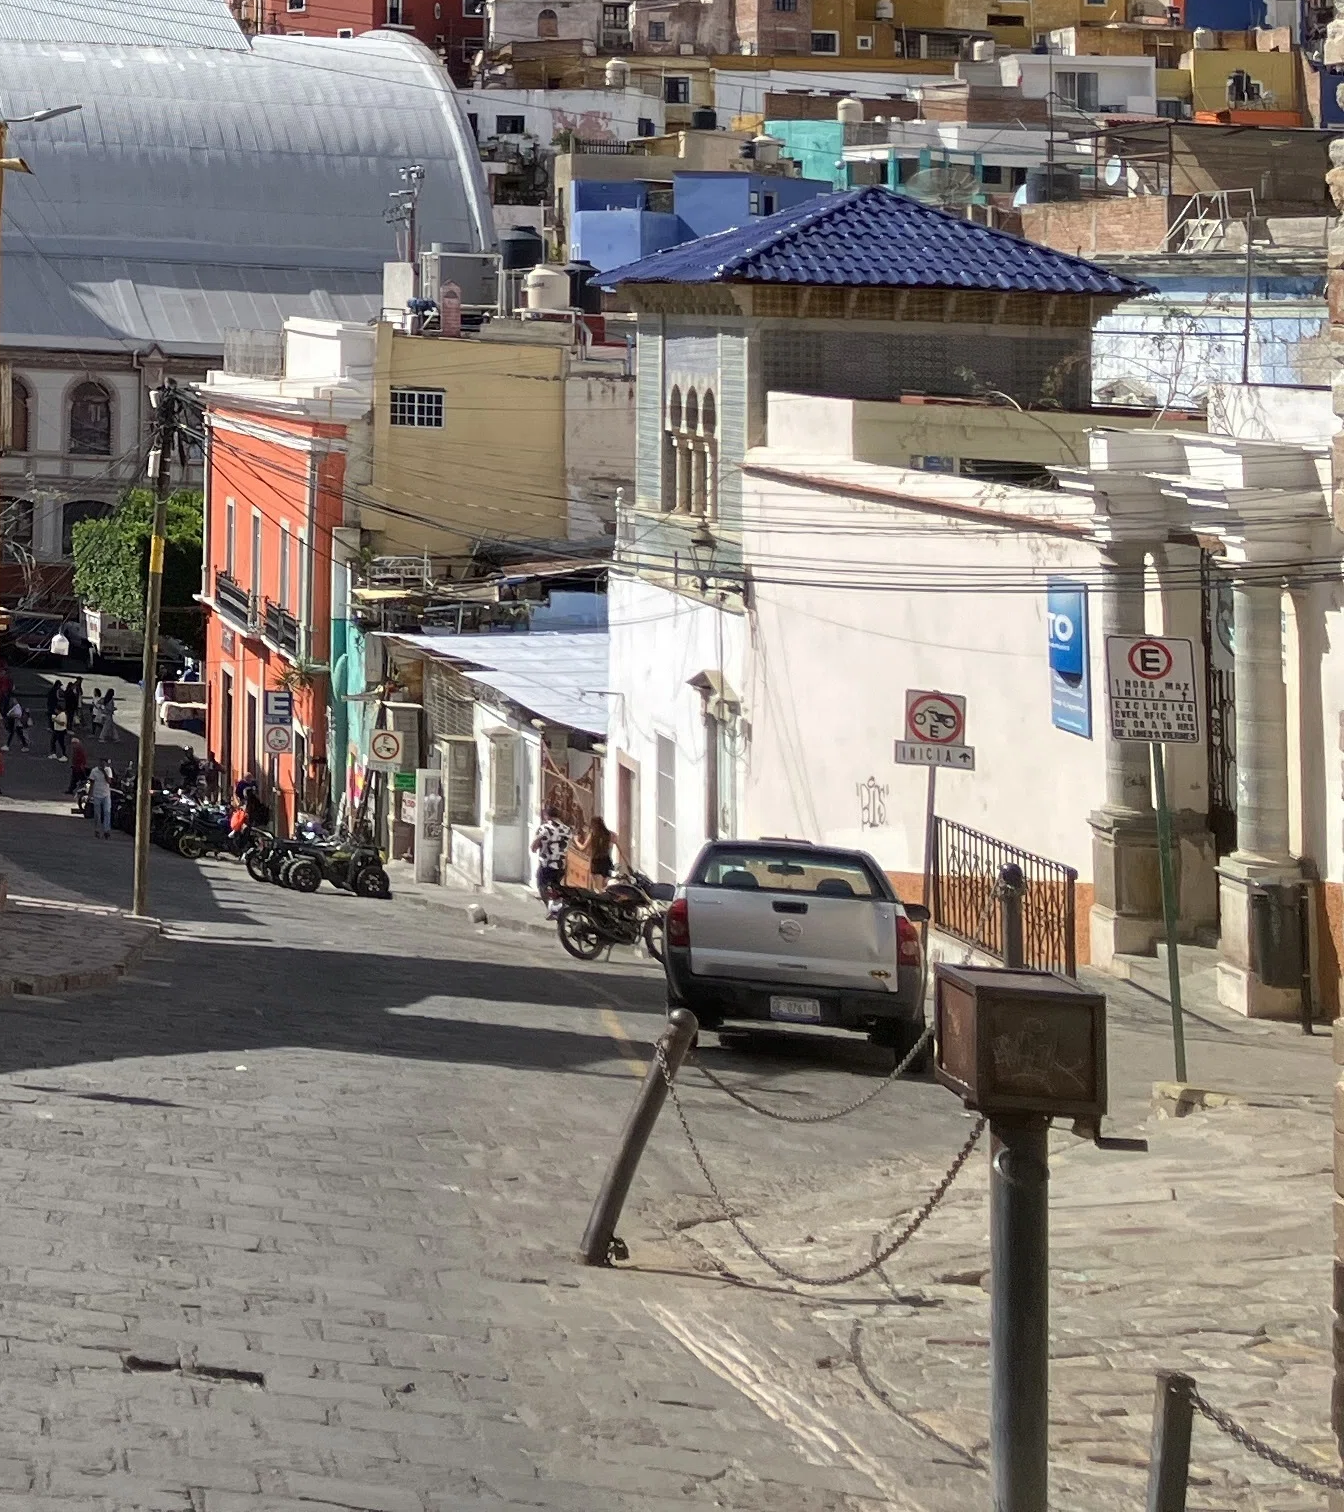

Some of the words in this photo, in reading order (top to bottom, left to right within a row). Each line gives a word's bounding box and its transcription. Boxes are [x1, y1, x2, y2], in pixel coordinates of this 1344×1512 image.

[1140, 648, 1160, 672] E
[1124, 679, 1155, 689] HORA
[1164, 681, 1190, 691] MAX
[1116, 688, 1165, 698] INICIA
[268, 692, 290, 715] E
[1115, 700, 1194, 712] EXCLUSIVO
[930, 724, 939, 738] E
[901, 745, 952, 763] INICIA
